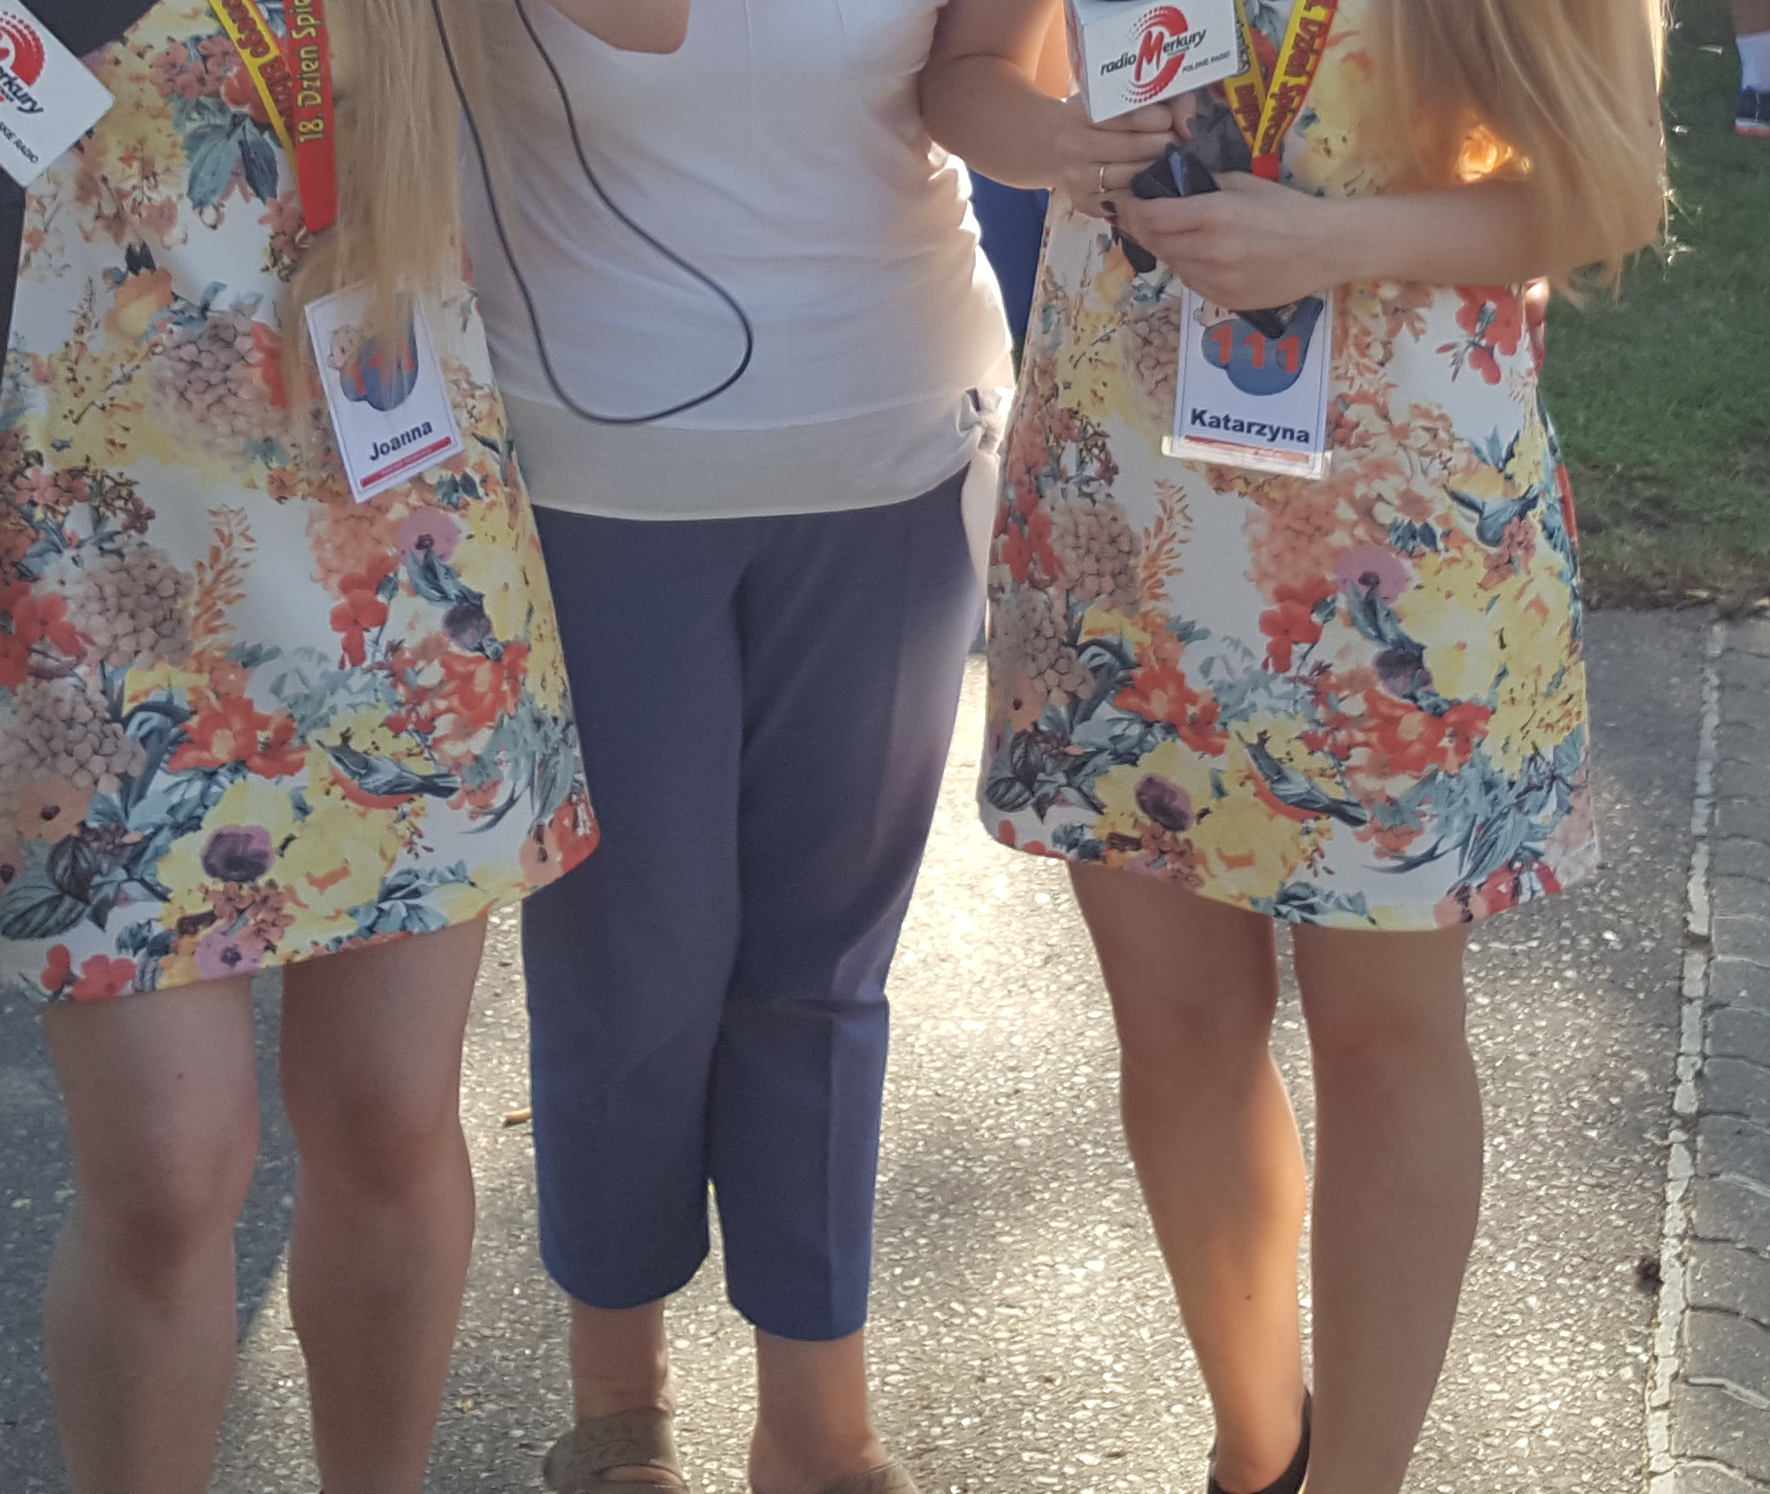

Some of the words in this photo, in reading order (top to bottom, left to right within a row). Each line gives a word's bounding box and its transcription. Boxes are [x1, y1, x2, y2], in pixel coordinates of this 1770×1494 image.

[1099, 51, 1137, 77] radio
[1133, 28, 1208, 83] Merkury
[296, 44, 324, 107] Dzień
[297, 112, 326, 143] 18.
[12, 137, 40, 165] RADIO
[368, 420, 434, 462] Joanna
[1189, 407, 1311, 444] Katarzyna
